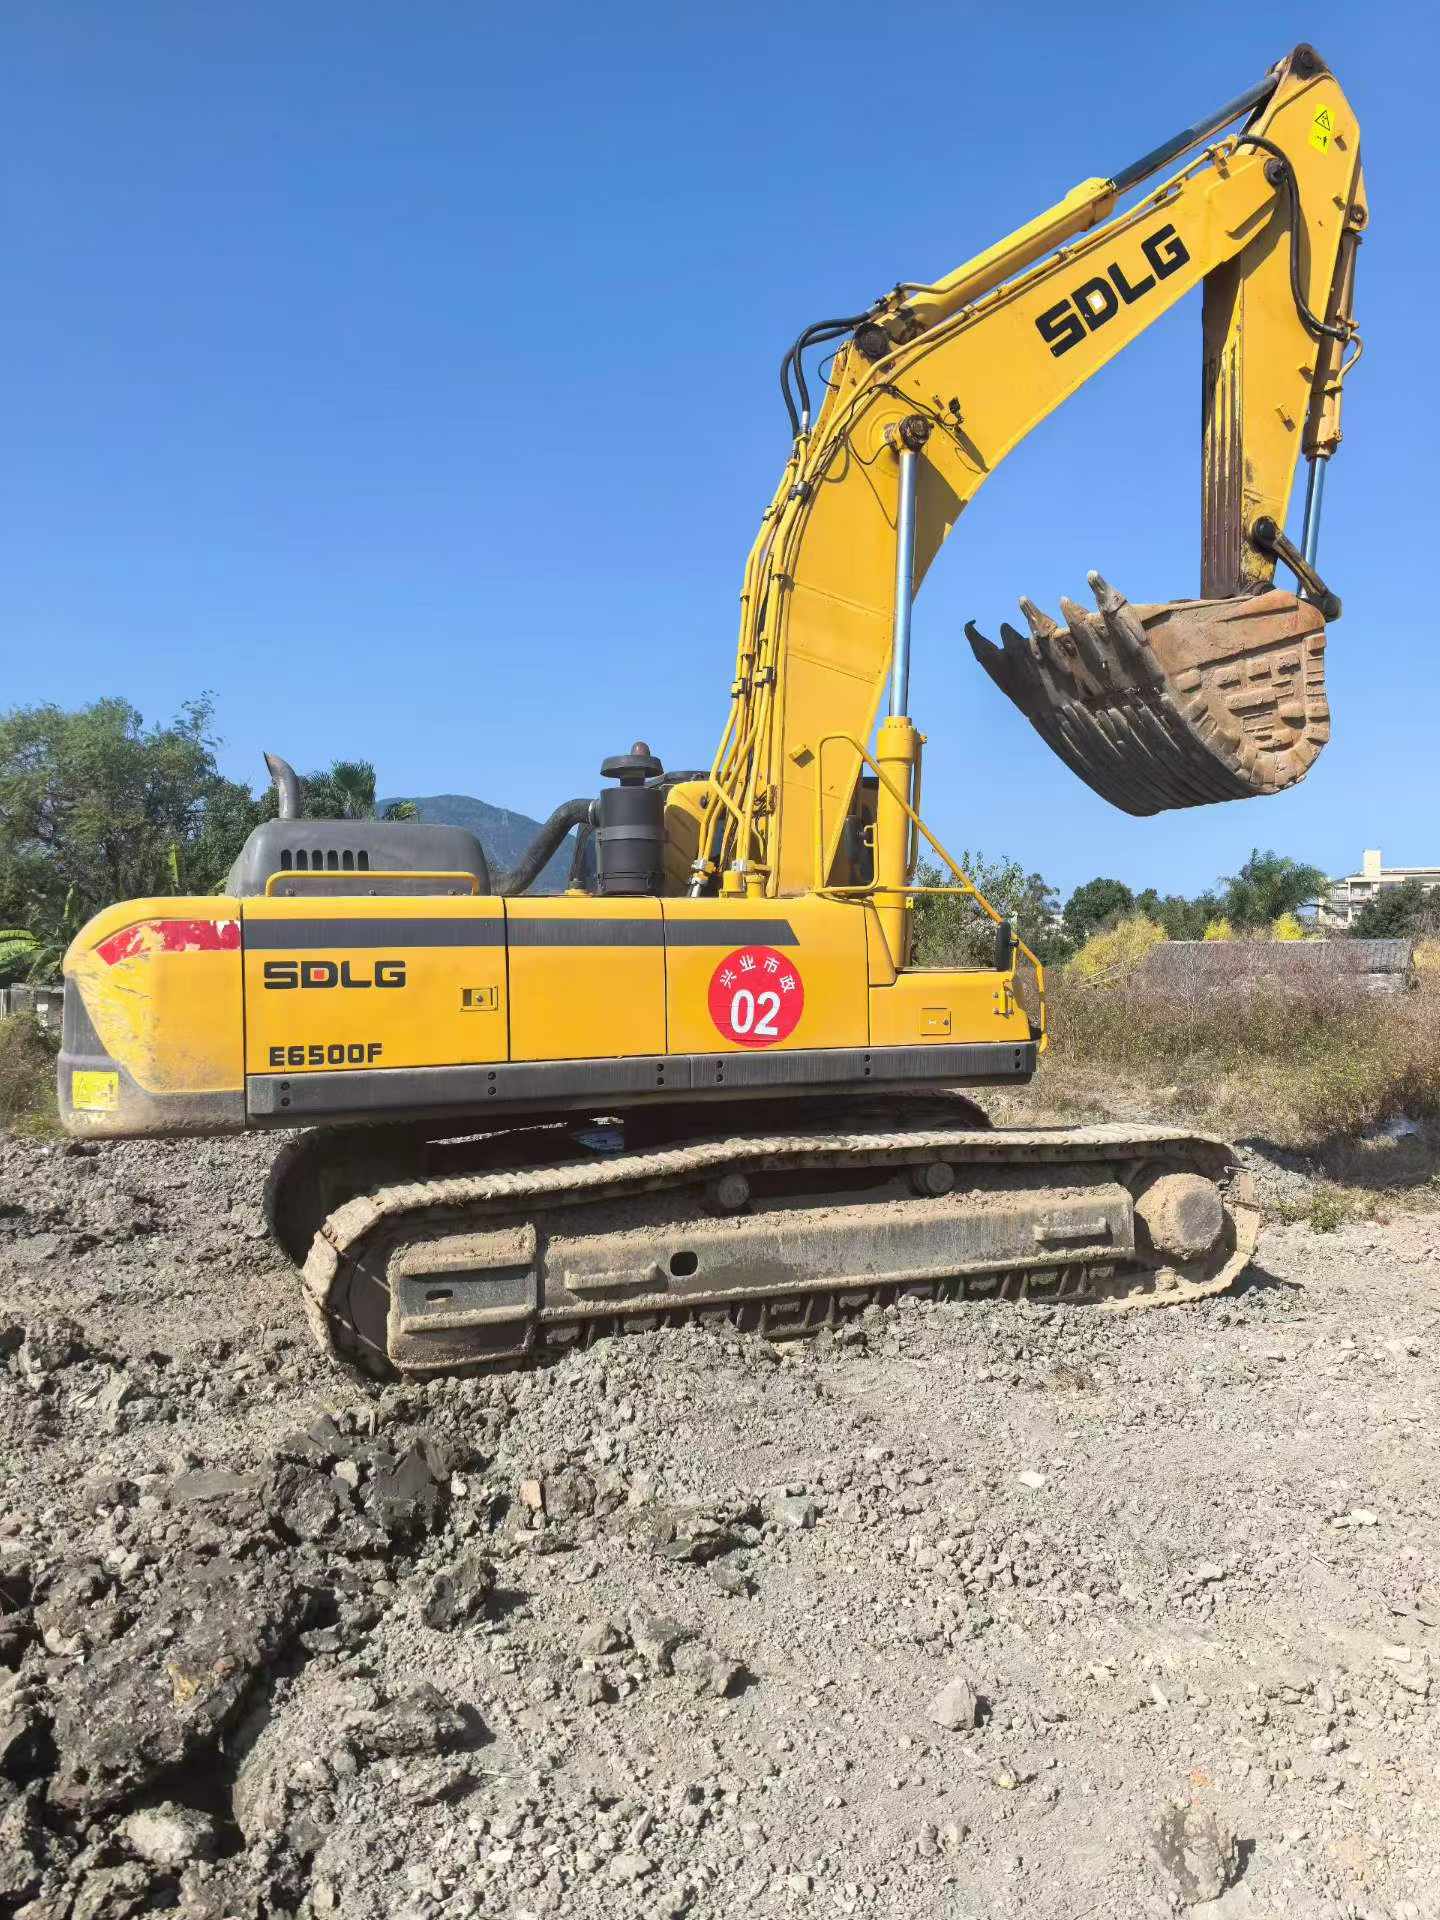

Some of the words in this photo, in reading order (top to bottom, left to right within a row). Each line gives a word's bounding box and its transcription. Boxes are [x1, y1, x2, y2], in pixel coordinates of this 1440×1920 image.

[1035, 223, 1190, 358] SDLG
[264, 960, 406, 989] SDLG
[730, 988, 781, 1036] 02
[269, 1042, 383, 1067] E6500F
